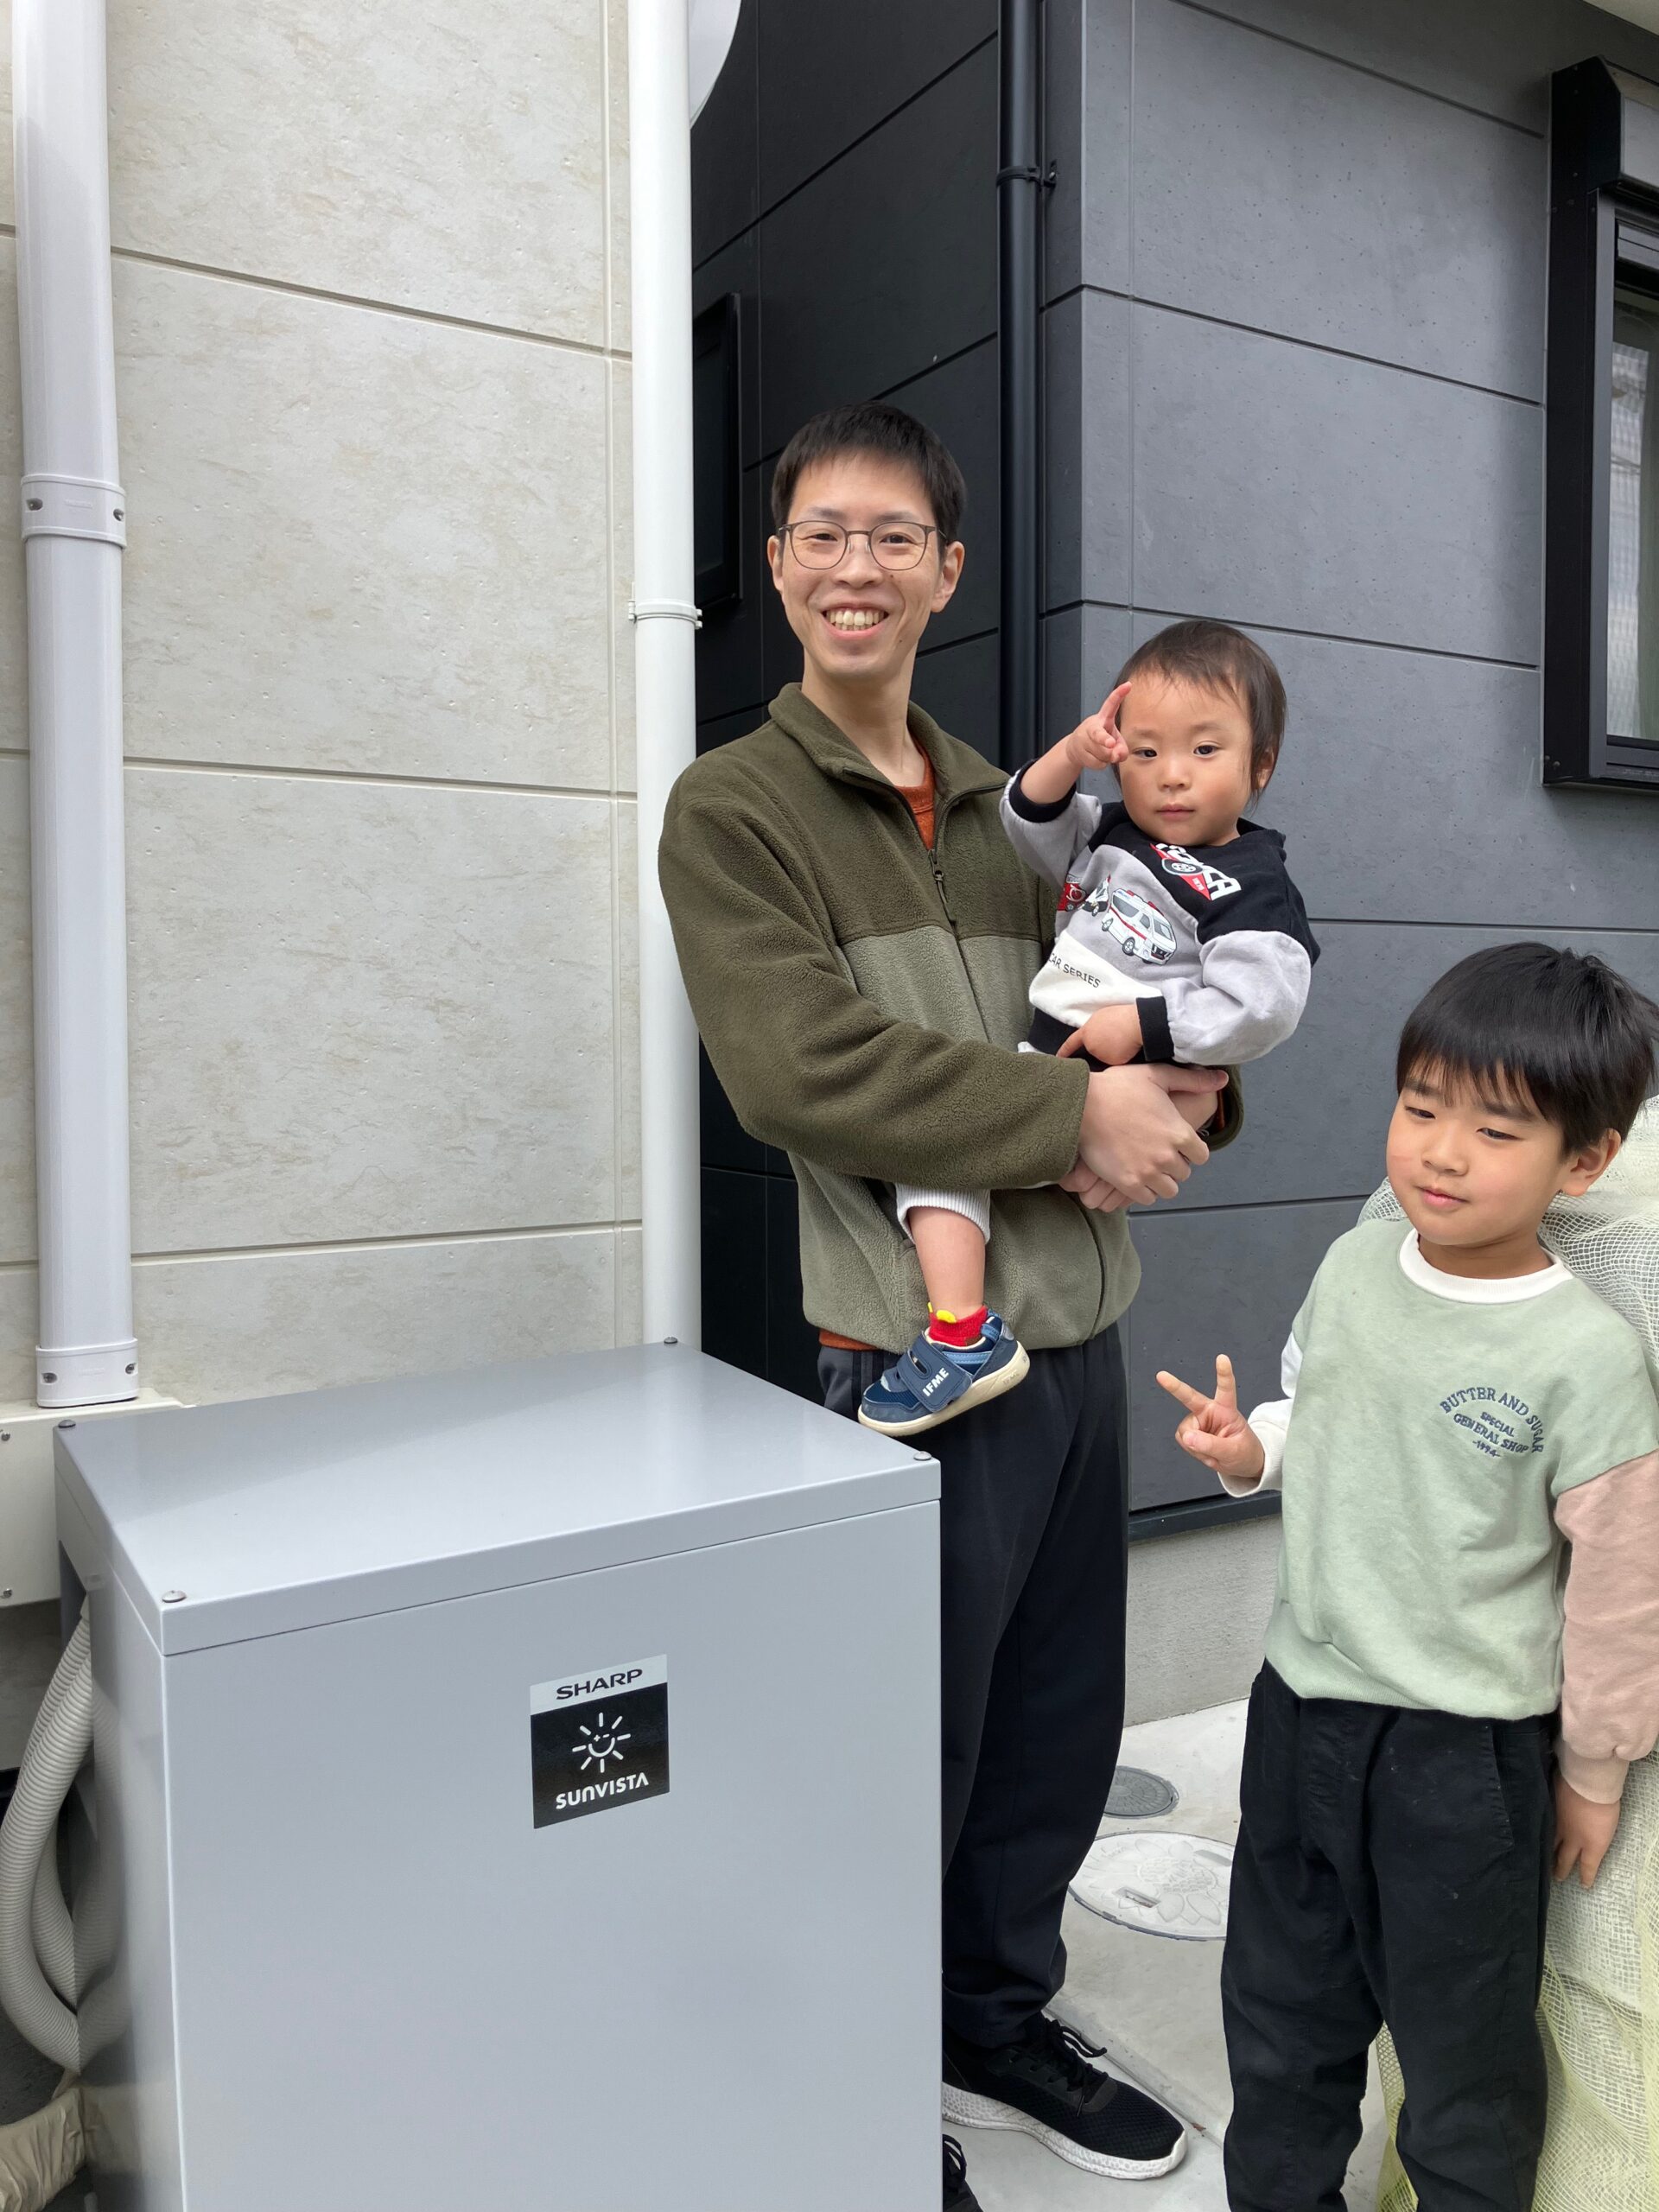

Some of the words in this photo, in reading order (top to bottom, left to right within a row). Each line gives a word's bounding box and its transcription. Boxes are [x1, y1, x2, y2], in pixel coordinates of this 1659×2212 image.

[1063, 963, 1101, 988] SERIES
[922, 1367, 950, 1397] IFME
[1440, 1387, 1497, 1414] BUTTER
[1498, 1392, 1529, 1416] AND
[1525, 1414, 1545, 1453] SUGAR
[1453, 1413, 1499, 1445] GENERAL
[1500, 1439, 1529, 1453] SHOP
[1480, 1411, 1515, 1437] SPECIAL
[556, 1669, 643, 1700] SHARP
